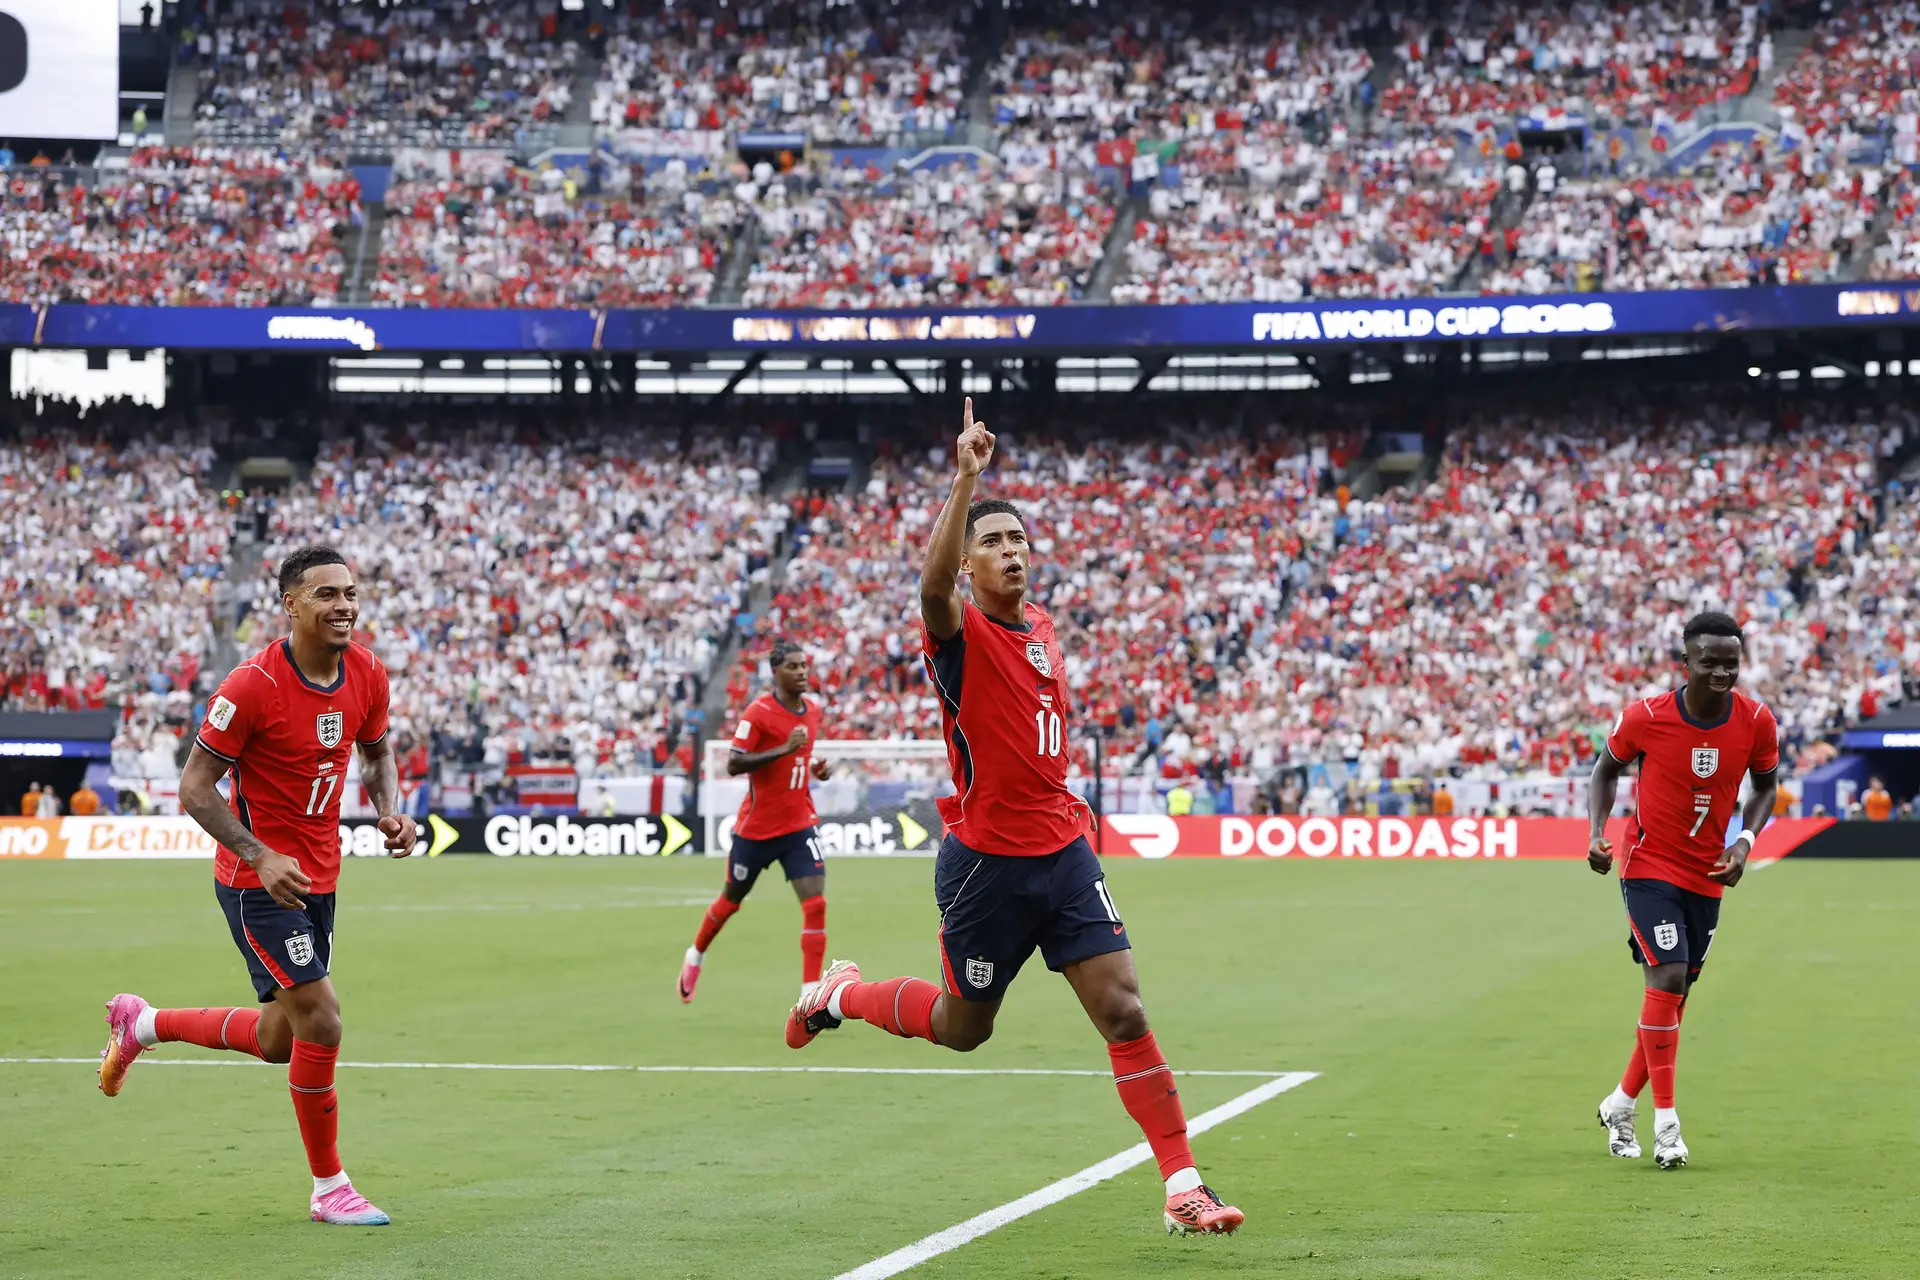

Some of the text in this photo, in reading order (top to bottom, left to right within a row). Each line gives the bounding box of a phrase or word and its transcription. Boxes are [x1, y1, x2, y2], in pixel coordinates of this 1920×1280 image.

[1253, 302, 1614, 340] FIFA WORLD CUP 2026
[1035, 710, 1060, 757] 10
[306, 774, 339, 815] 17
[790, 765, 806, 790] 11
[484, 814, 661, 857] Globant
[1220, 817, 1518, 858] DOORDASH
[1689, 806, 1710, 837] 7
